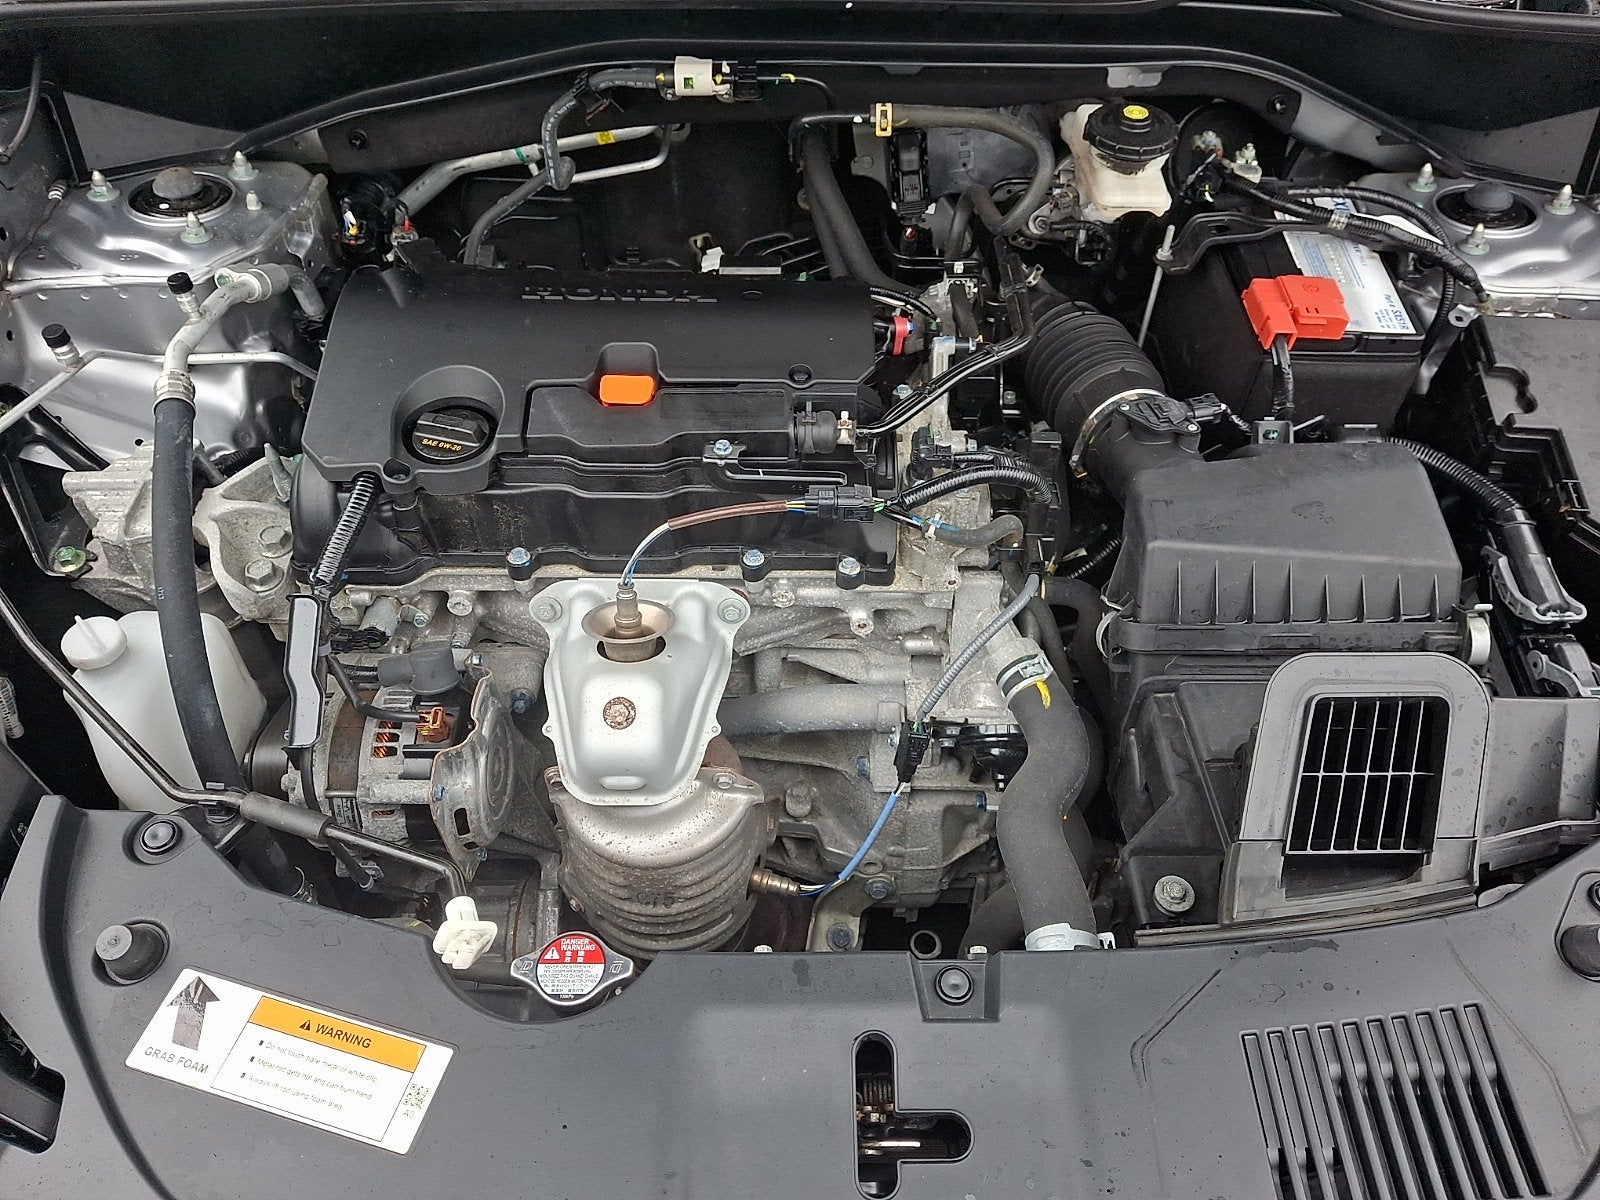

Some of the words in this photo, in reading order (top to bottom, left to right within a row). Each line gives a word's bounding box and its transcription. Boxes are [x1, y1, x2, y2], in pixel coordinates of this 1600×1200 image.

[521, 286, 718, 303] HONDA
[421, 438, 439, 448] SAE
[438, 441, 462, 452] 0W-20
[315, 1022, 372, 1049] WARNING
[144, 1046, 176, 1063] GRAB
[176, 1056, 209, 1074] FOAM
[265, 1041, 275, 1050] Do
[277, 1046, 287, 1054] not
[288, 1049, 305, 1060] touch
[306, 1055, 320, 1065] bare
[322, 1060, 340, 1070] metal
[348, 1069, 365, 1079] white
[280, 1086, 291, 1094] rod
[291, 1090, 309, 1100] using
[310, 1094, 327, 1104] foam
[328, 1101, 343, 1111] area
[286, 1069, 301, 1079] gets
[313, 1077, 326, 1086] and
[326, 1081, 339, 1089] can
[340, 1084, 355, 1093] burn
[355, 1089, 373, 1101] hand
